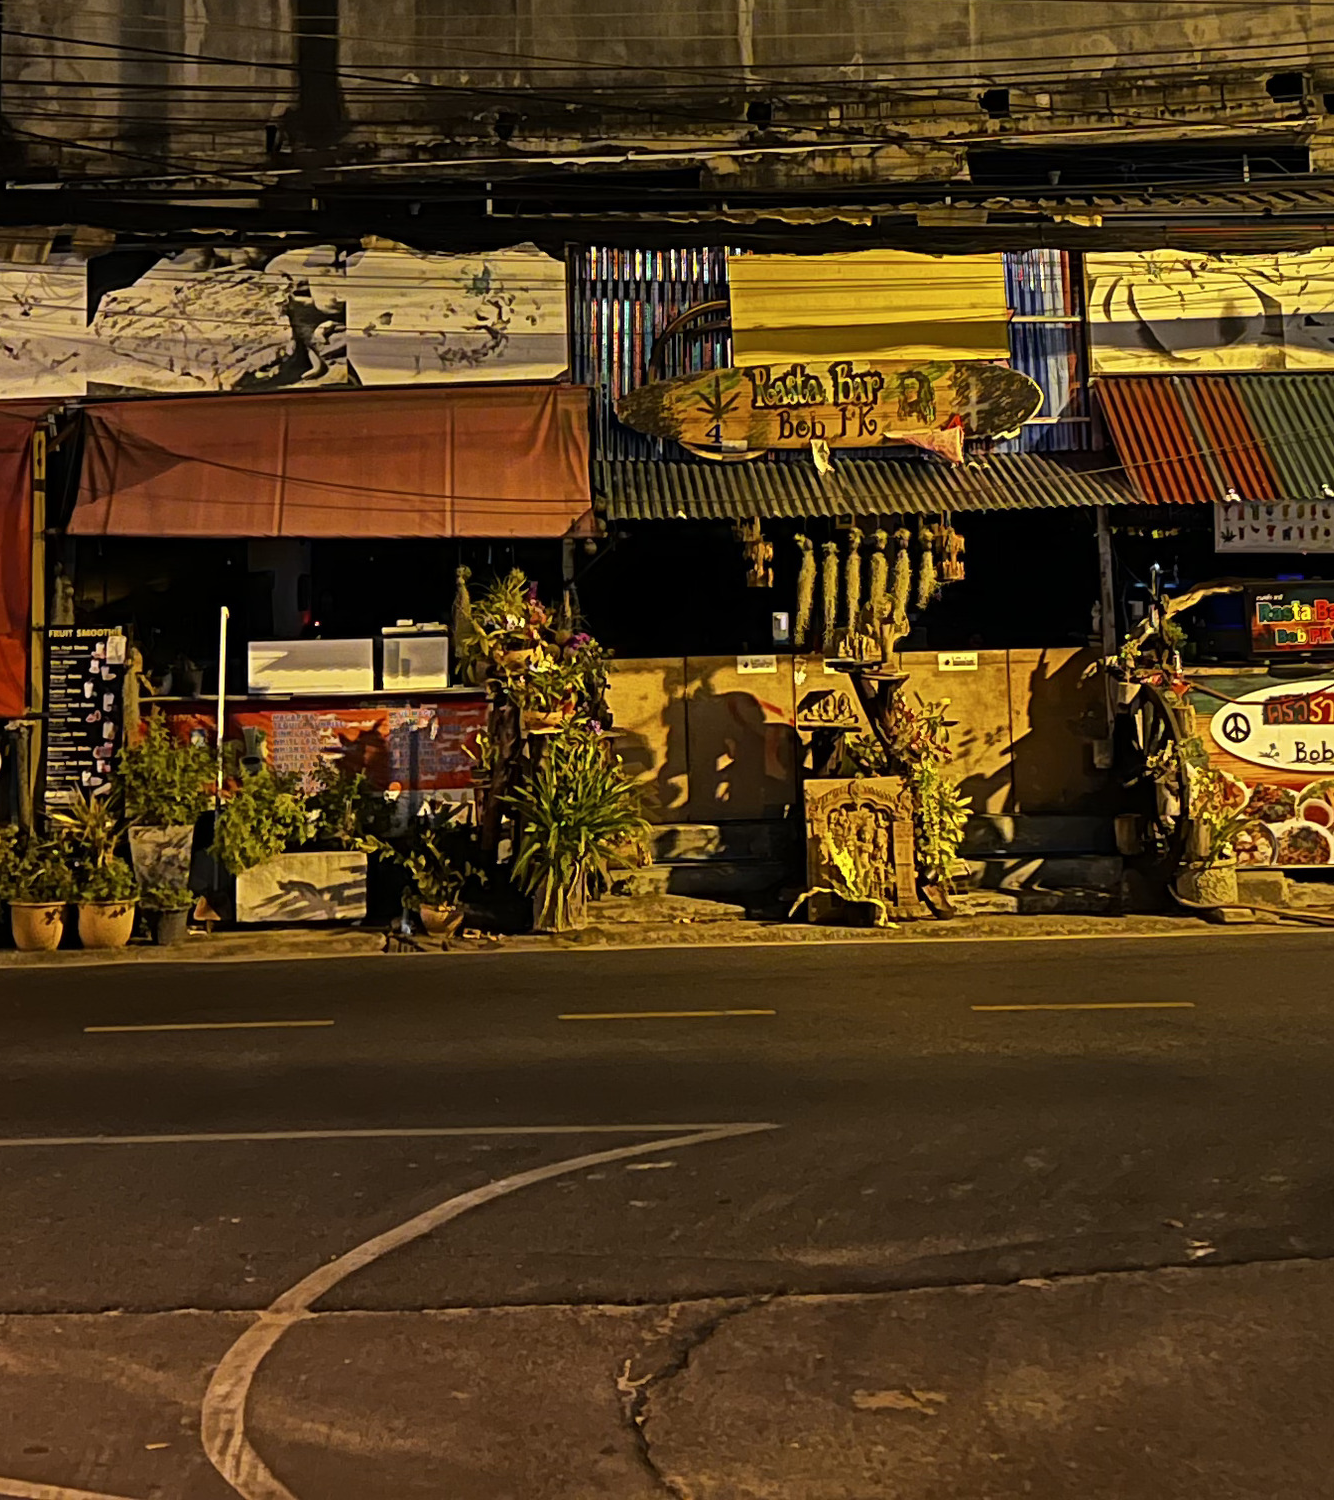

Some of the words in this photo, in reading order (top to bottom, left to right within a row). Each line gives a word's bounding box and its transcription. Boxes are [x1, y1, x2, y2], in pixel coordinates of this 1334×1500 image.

[751, 363, 825, 408] Rasta
[831, 362, 881, 405] Bar
[777, 410, 826, 440] Bob
[1256, 601, 1312, 624] Rasta
[49, 629, 73, 638] FRUIT
[1275, 626, 1307, 645] Bob
[1308, 625, 1334, 645] PK
[1294, 740, 1334, 762] Bob
